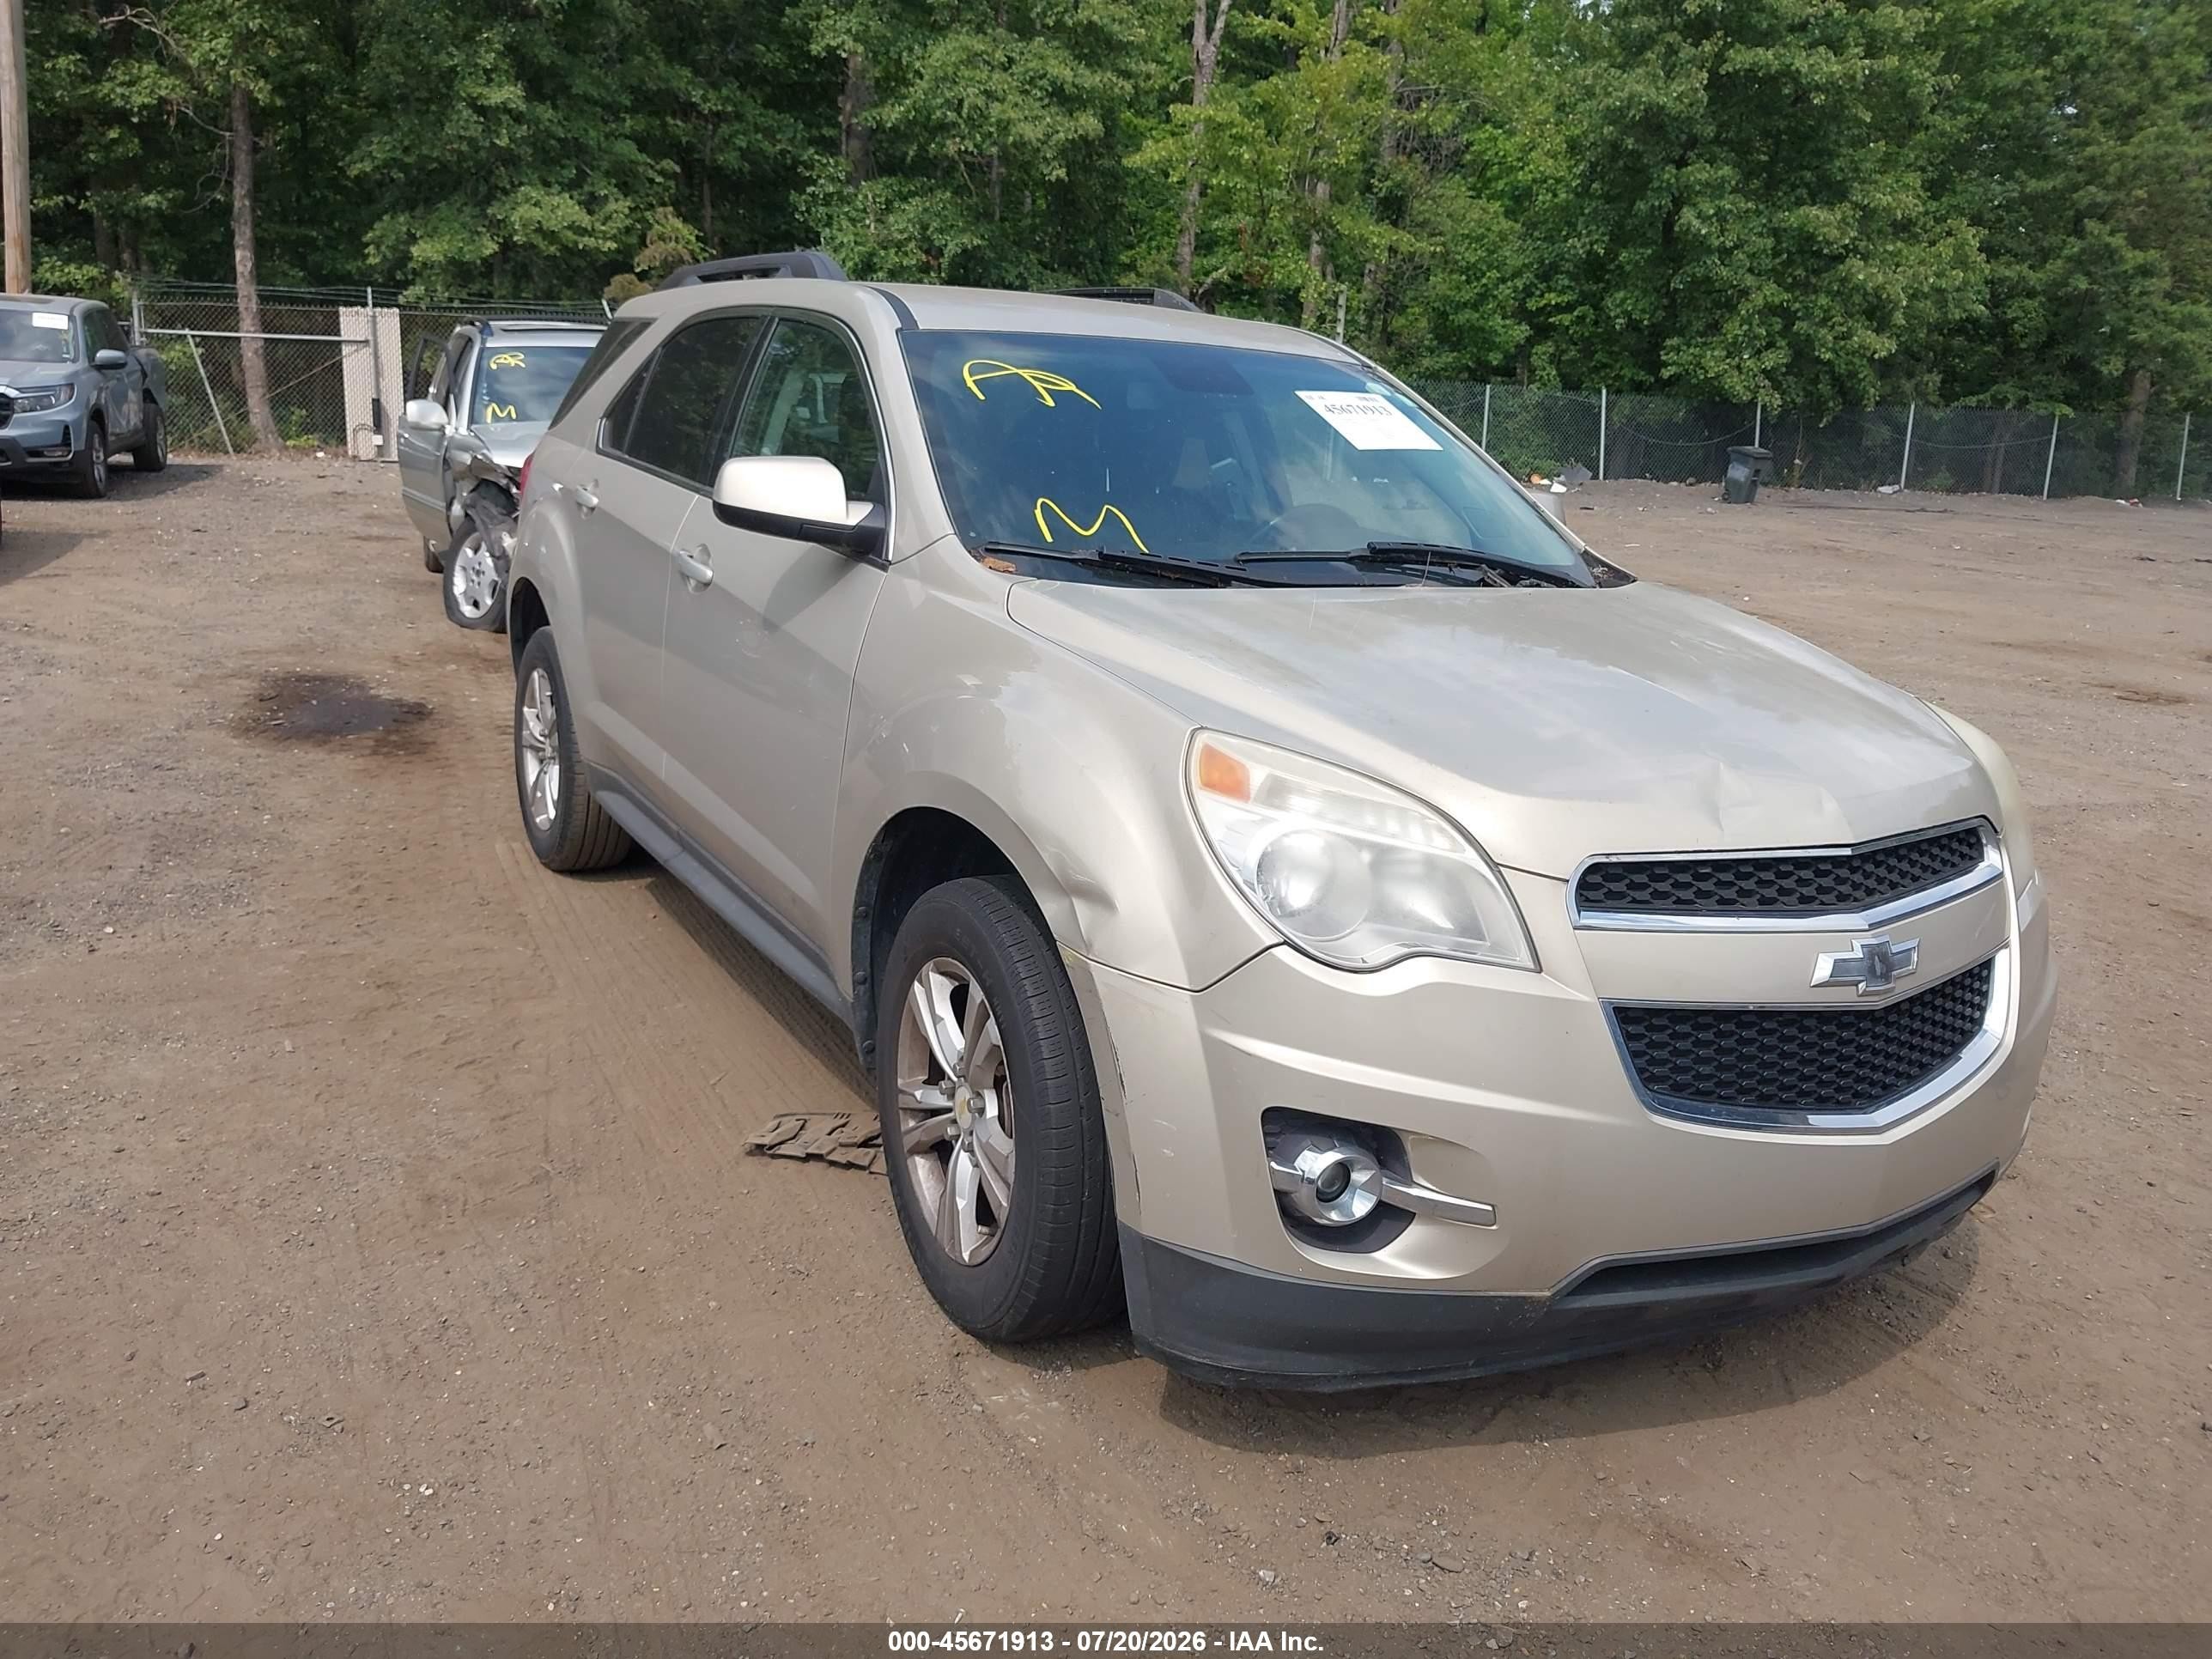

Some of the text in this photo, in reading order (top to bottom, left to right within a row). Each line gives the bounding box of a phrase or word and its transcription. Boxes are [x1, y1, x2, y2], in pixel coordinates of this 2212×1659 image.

[485, 402, 517, 424] M
[1323, 404, 1393, 416] 45671913
[1033, 496, 1150, 554] M
